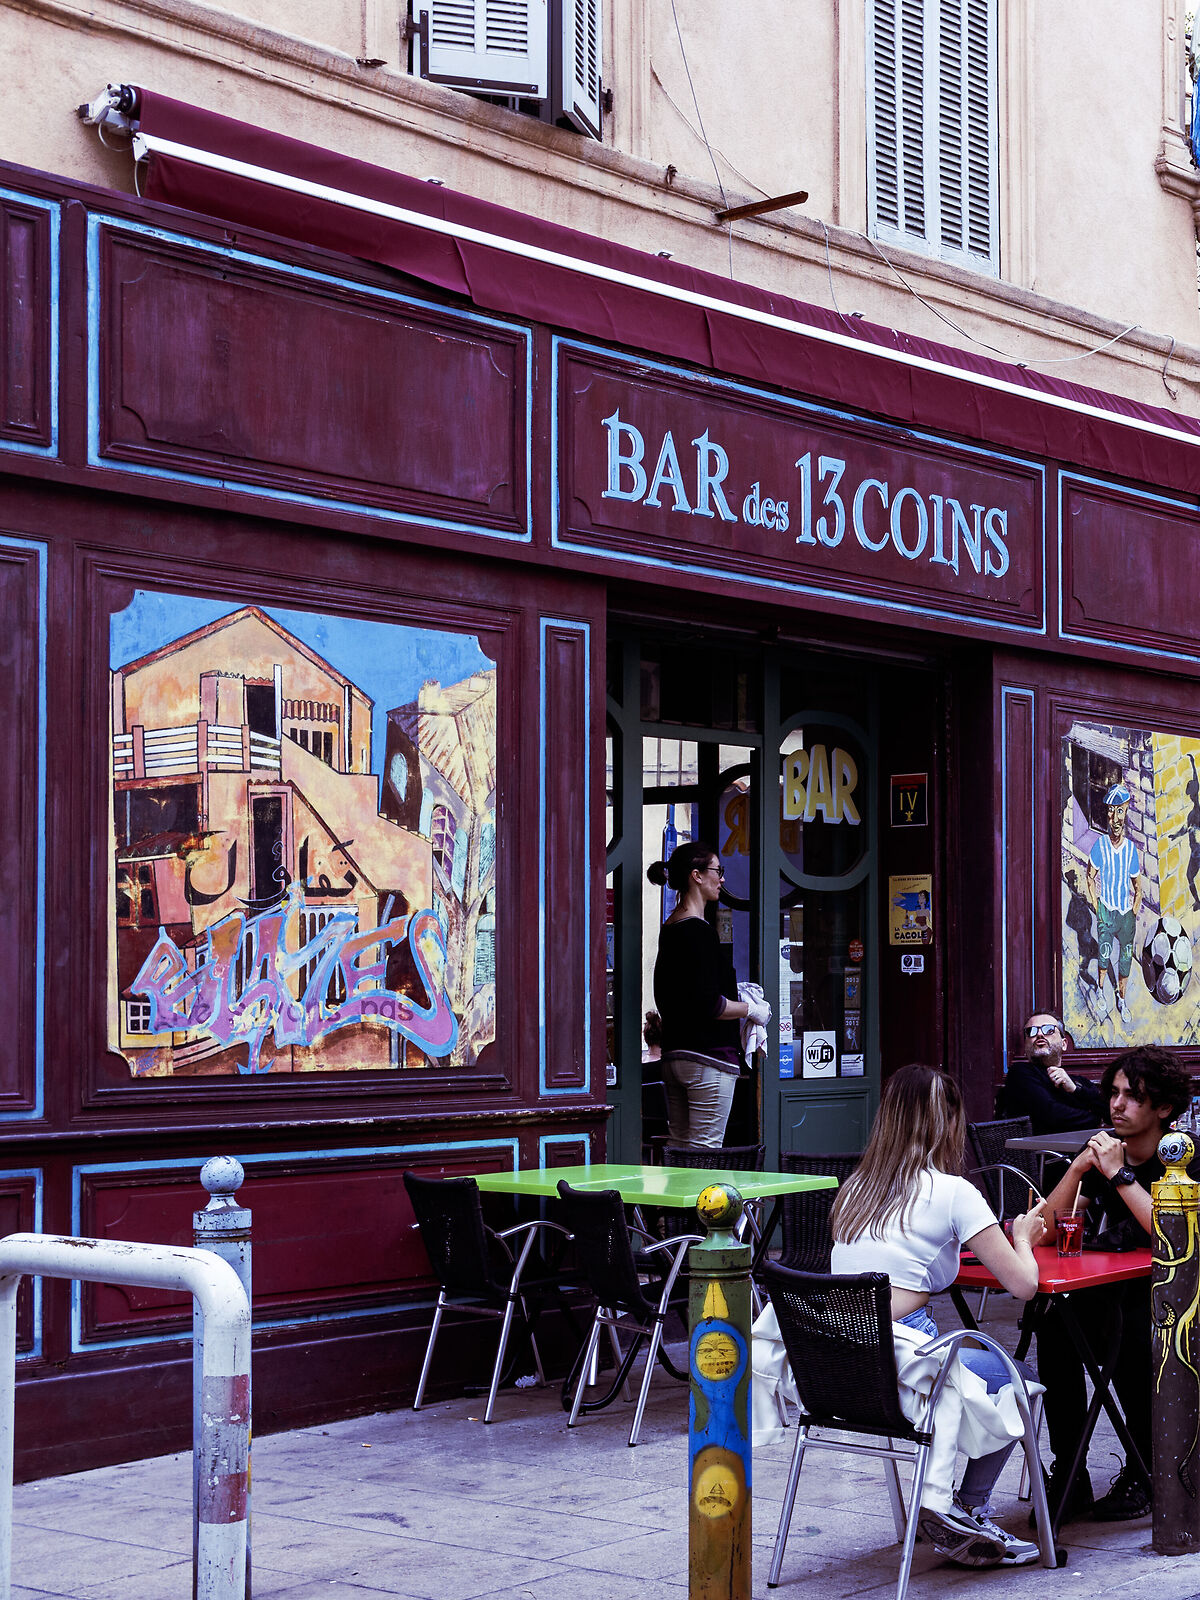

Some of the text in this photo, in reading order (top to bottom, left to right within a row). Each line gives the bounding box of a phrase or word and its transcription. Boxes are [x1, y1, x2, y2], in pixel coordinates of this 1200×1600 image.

[601, 407, 1010, 579] BAR des 13 COINS
[783, 744, 861, 825] BAR
